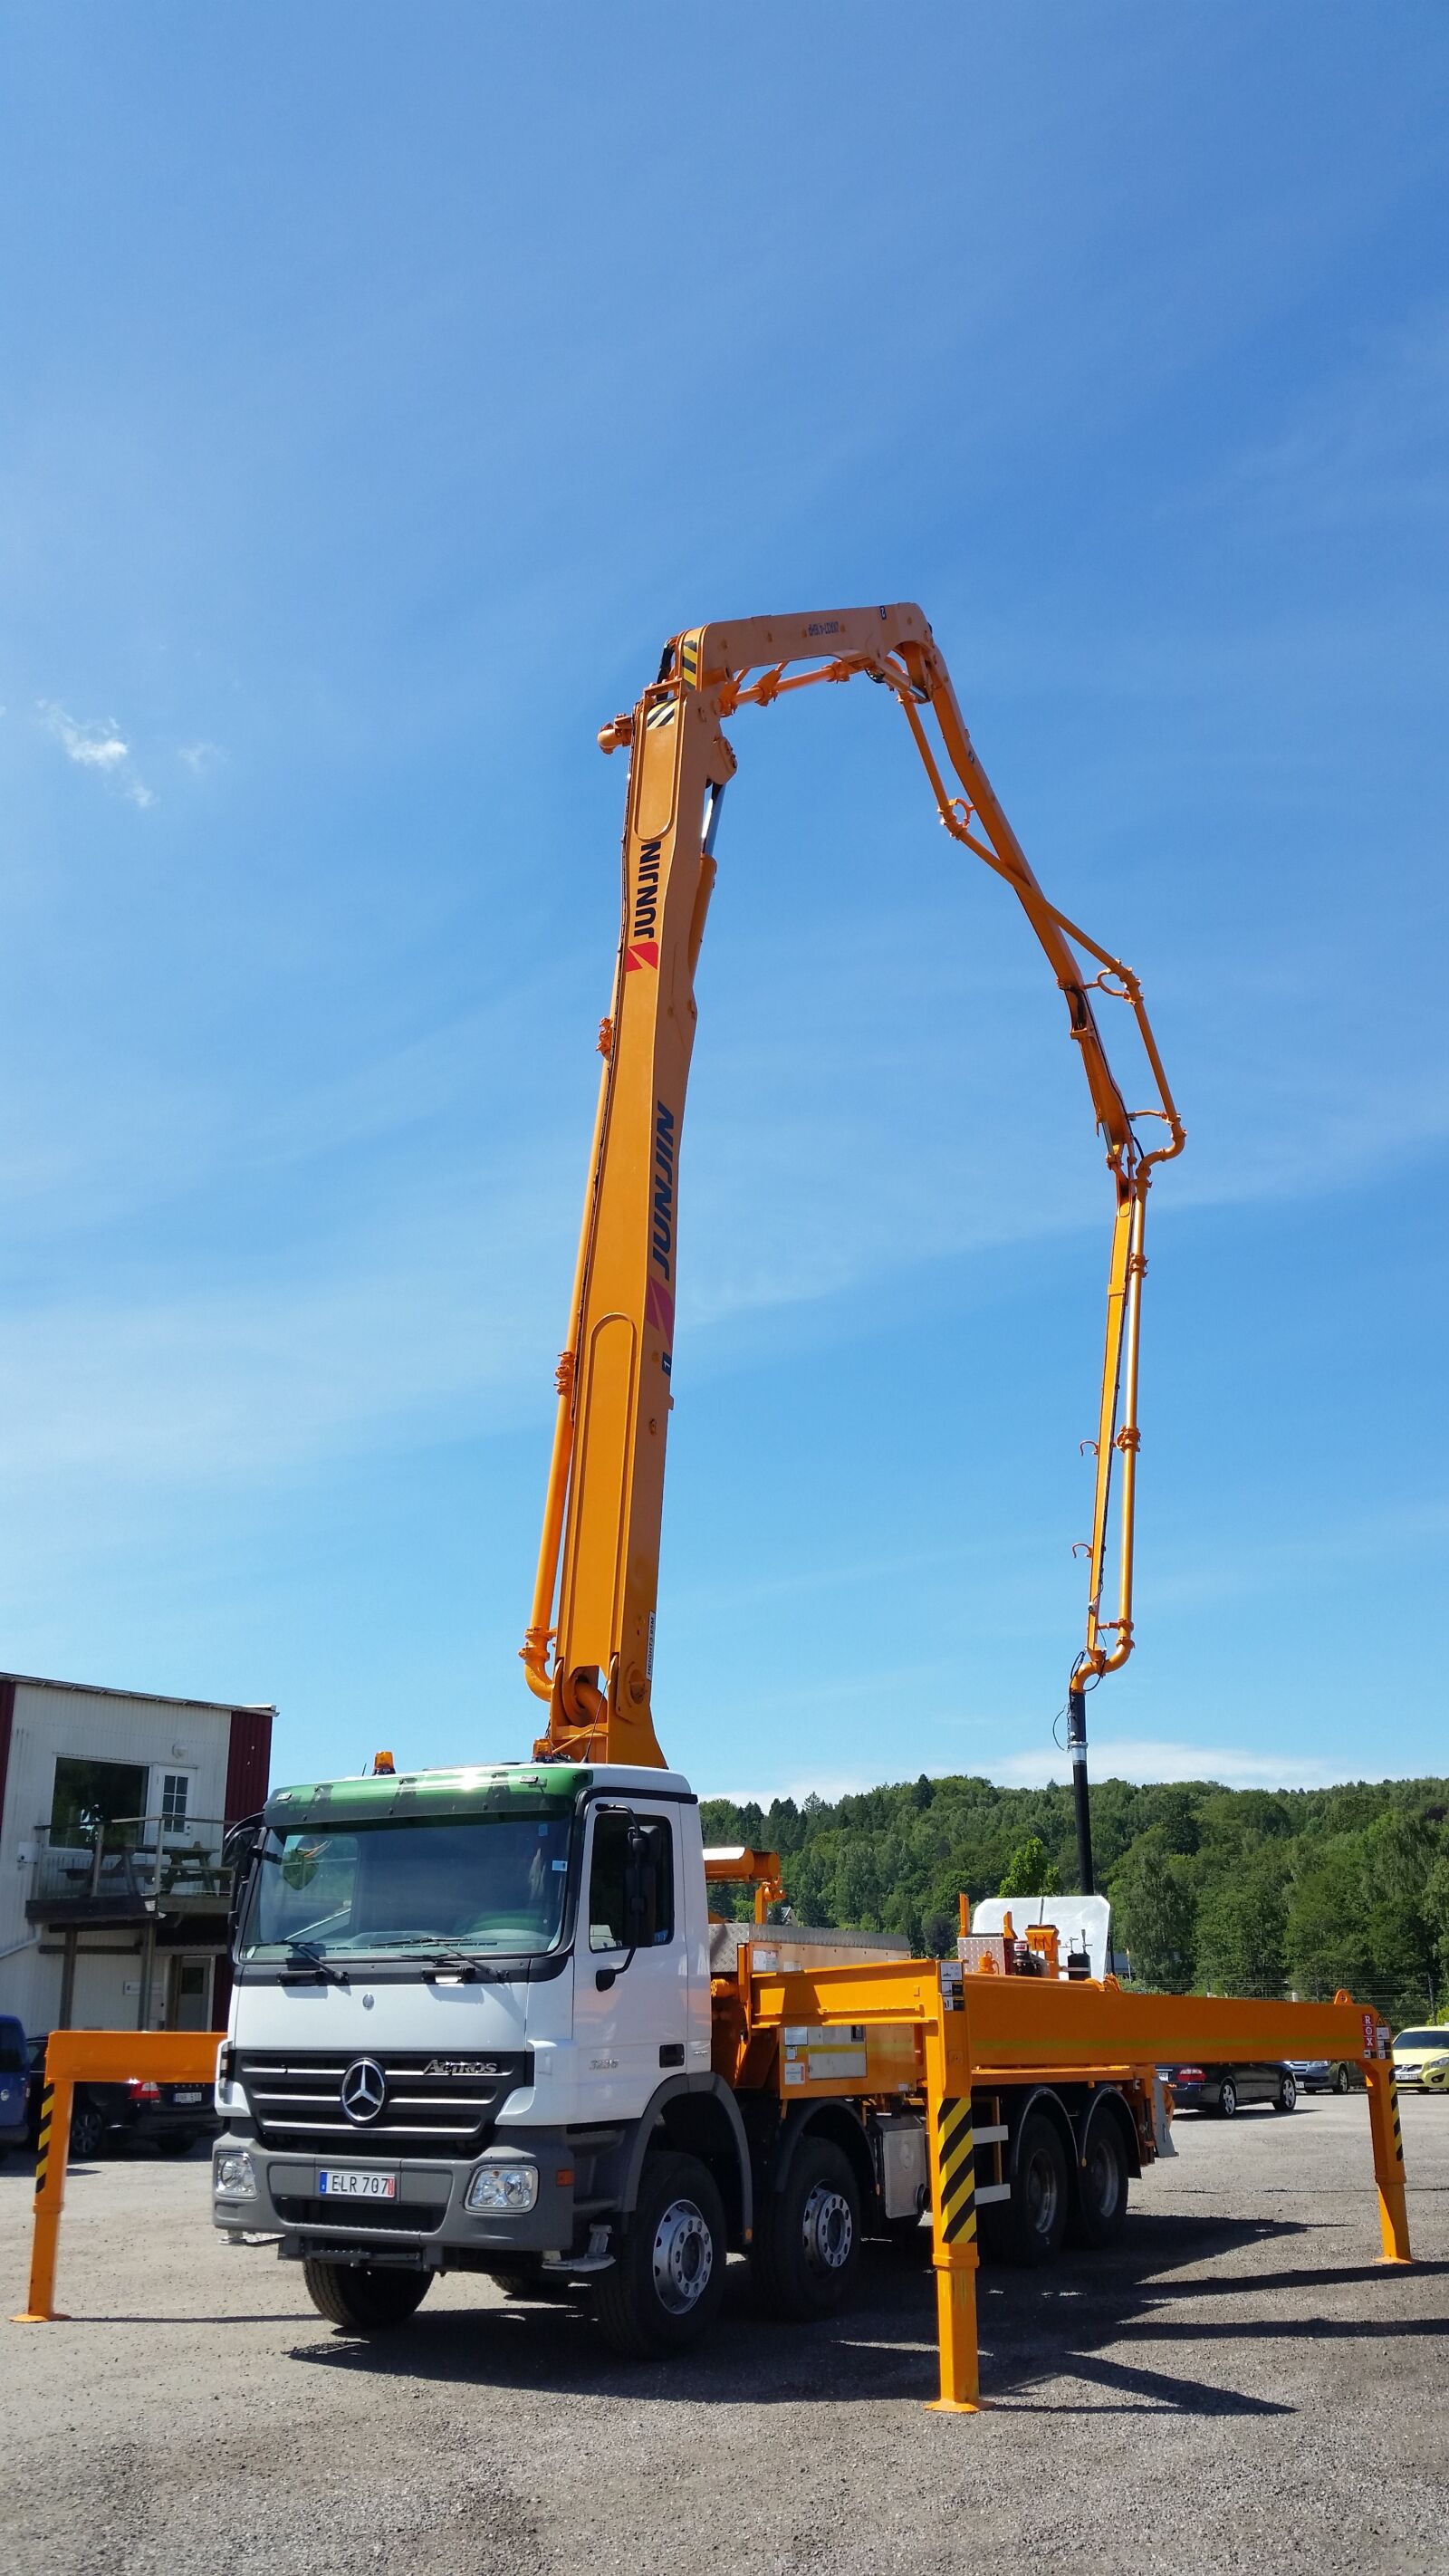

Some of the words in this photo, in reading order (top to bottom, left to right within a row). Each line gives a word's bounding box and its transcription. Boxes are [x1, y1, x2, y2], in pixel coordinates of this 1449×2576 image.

[633, 841, 662, 939] JUNJIN
[652, 1101, 675, 1282] JUNJIN
[331, 2175, 358, 2193] ELR
[362, 2177, 389, 2195] 707
